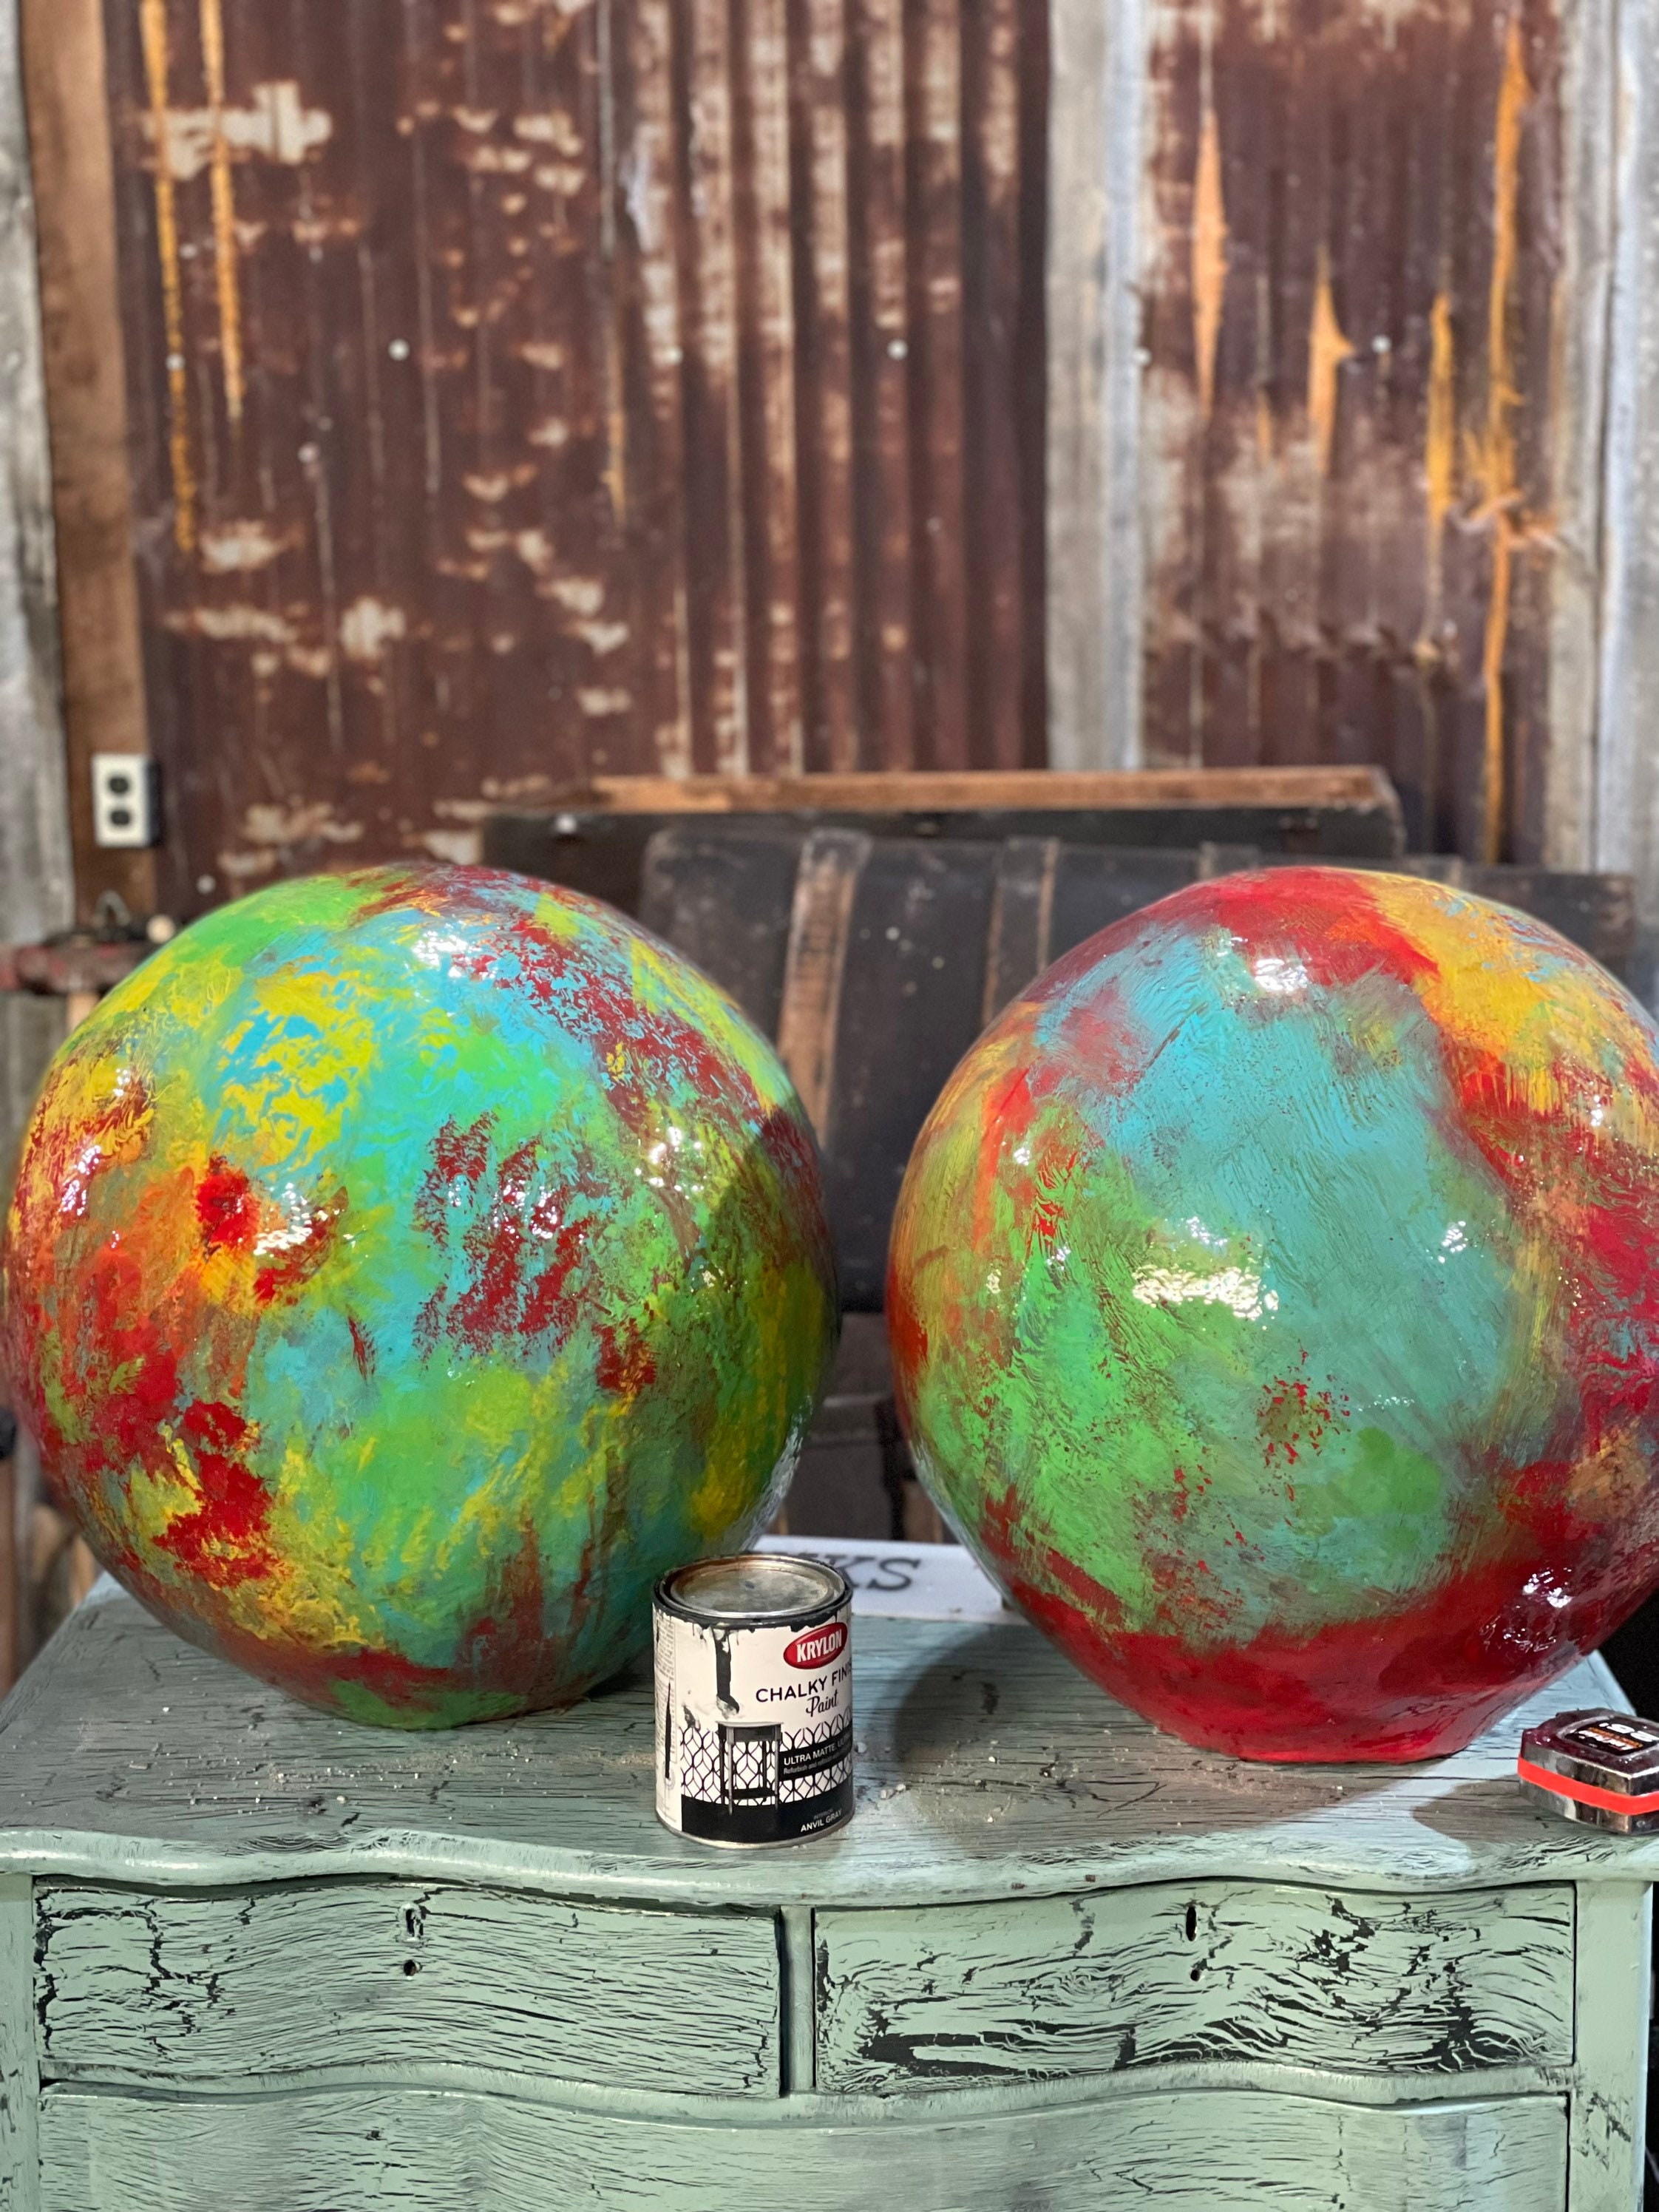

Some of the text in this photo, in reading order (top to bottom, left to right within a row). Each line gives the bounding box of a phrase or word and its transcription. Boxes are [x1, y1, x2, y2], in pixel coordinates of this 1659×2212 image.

[796, 1629, 842, 1663] KRYLON
[756, 1675, 827, 1703] CHALKY
[805, 1689, 838, 1717] Paint
[784, 1753, 811, 1765] ULTRA
[800, 1819, 824, 1833] ANVIL
[825, 1808, 843, 1824] GRAY
